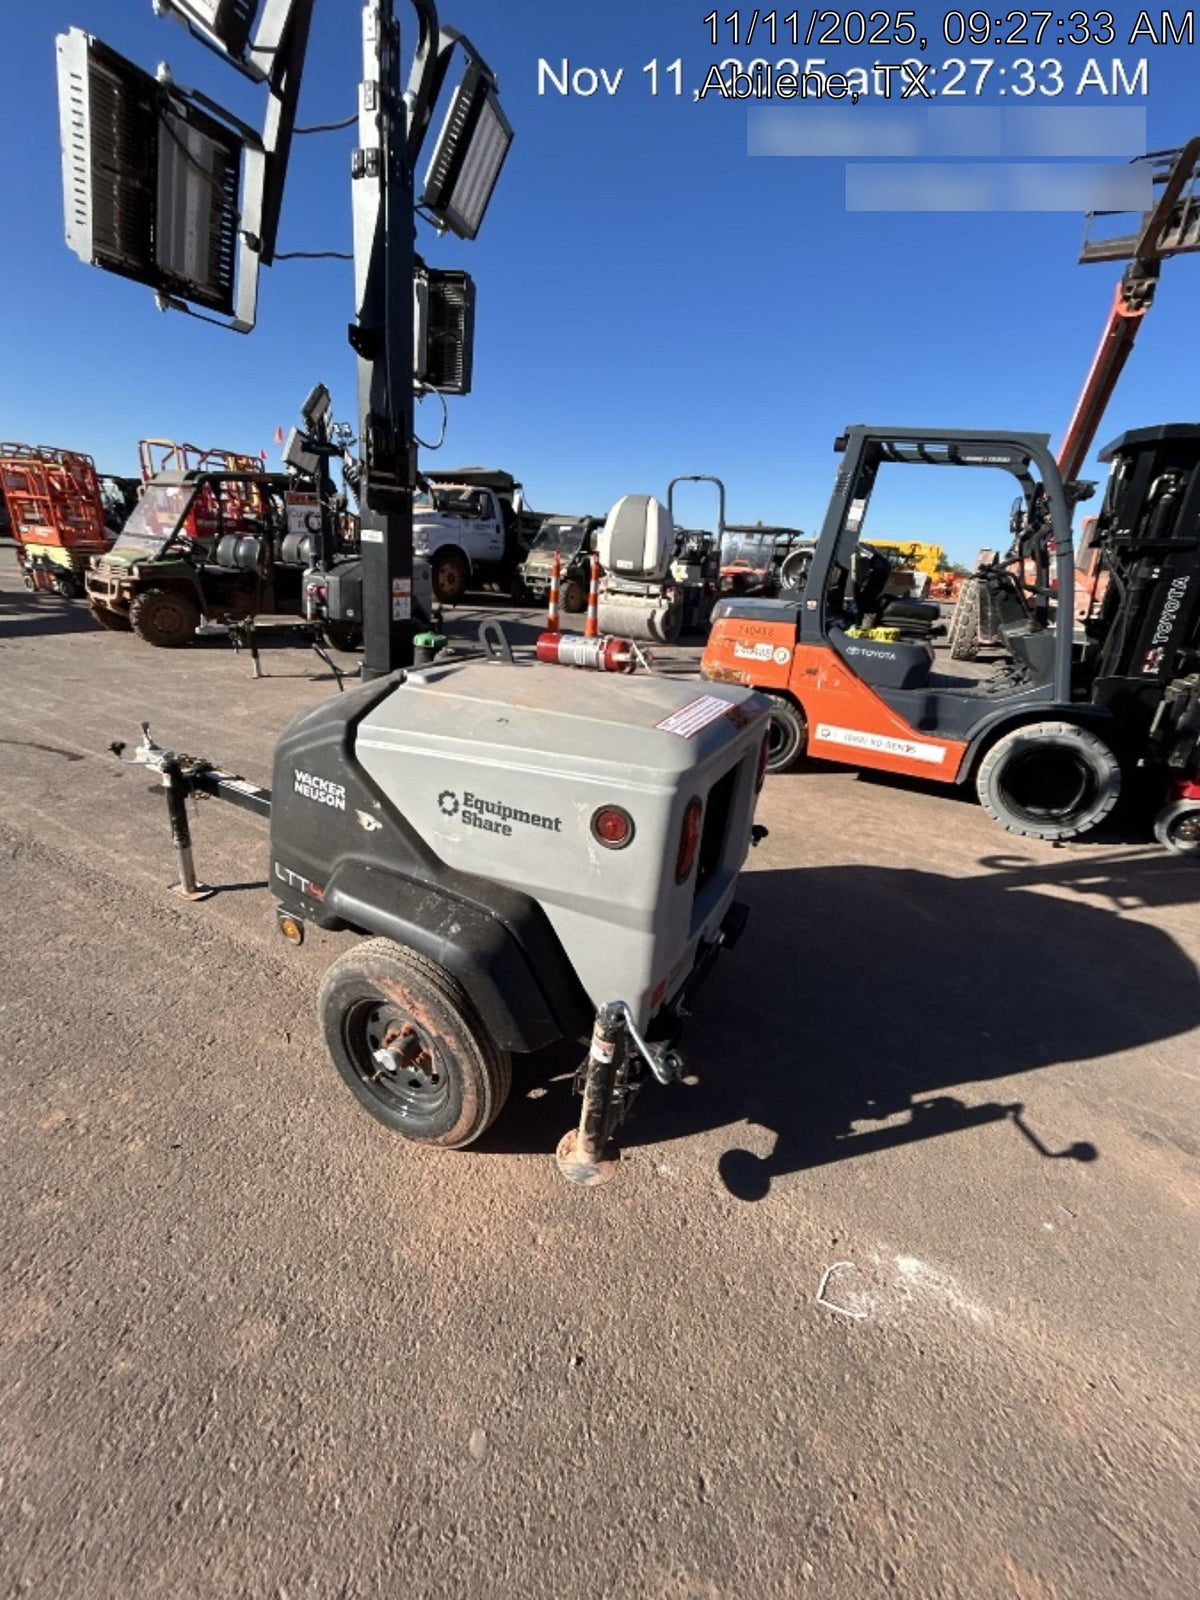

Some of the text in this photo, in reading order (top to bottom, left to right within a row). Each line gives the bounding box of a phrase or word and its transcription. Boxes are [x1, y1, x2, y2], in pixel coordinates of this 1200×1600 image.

[1152, 575, 1191, 645] TOYOTA
[861, 648, 896, 660] TOYOTA
[294, 768, 346, 799] WACKER
[294, 780, 346, 811] NEUSON
[461, 809, 513, 836] Share
[462, 791, 563, 832] Equipment
